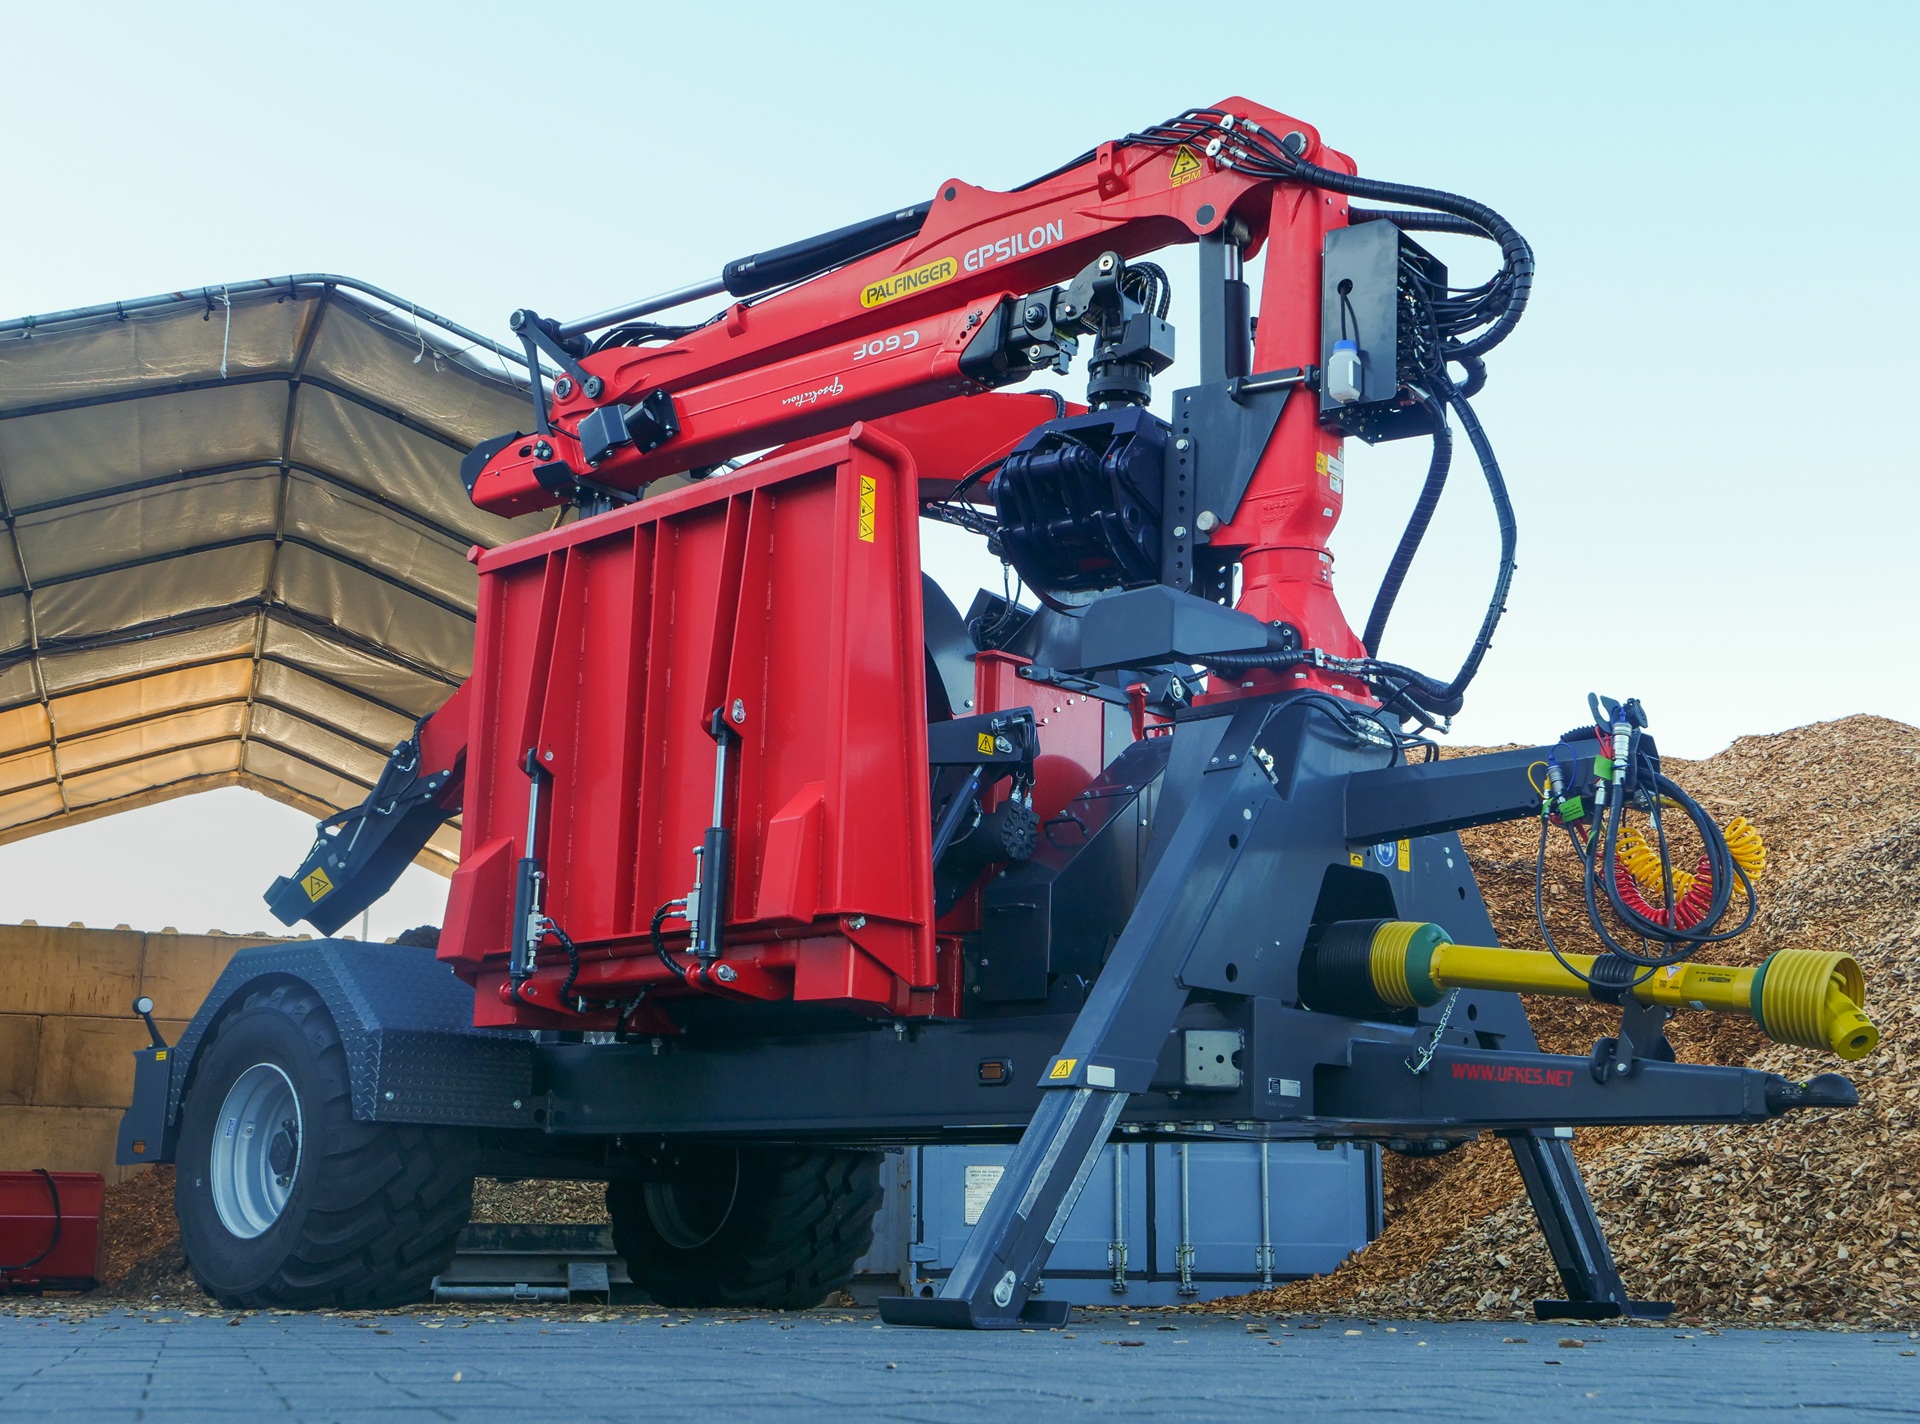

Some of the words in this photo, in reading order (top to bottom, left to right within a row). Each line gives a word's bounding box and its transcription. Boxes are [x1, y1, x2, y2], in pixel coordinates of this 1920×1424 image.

[1172, 171, 1201, 188] 20M
[866, 261, 952, 304] PALFINGER
[963, 219, 1064, 272] EPSILON
[853, 329, 920, 361] C60F
[782, 376, 844, 407] Epsolution
[1451, 1062, 1574, 1087] WWW.UFKES.NET
